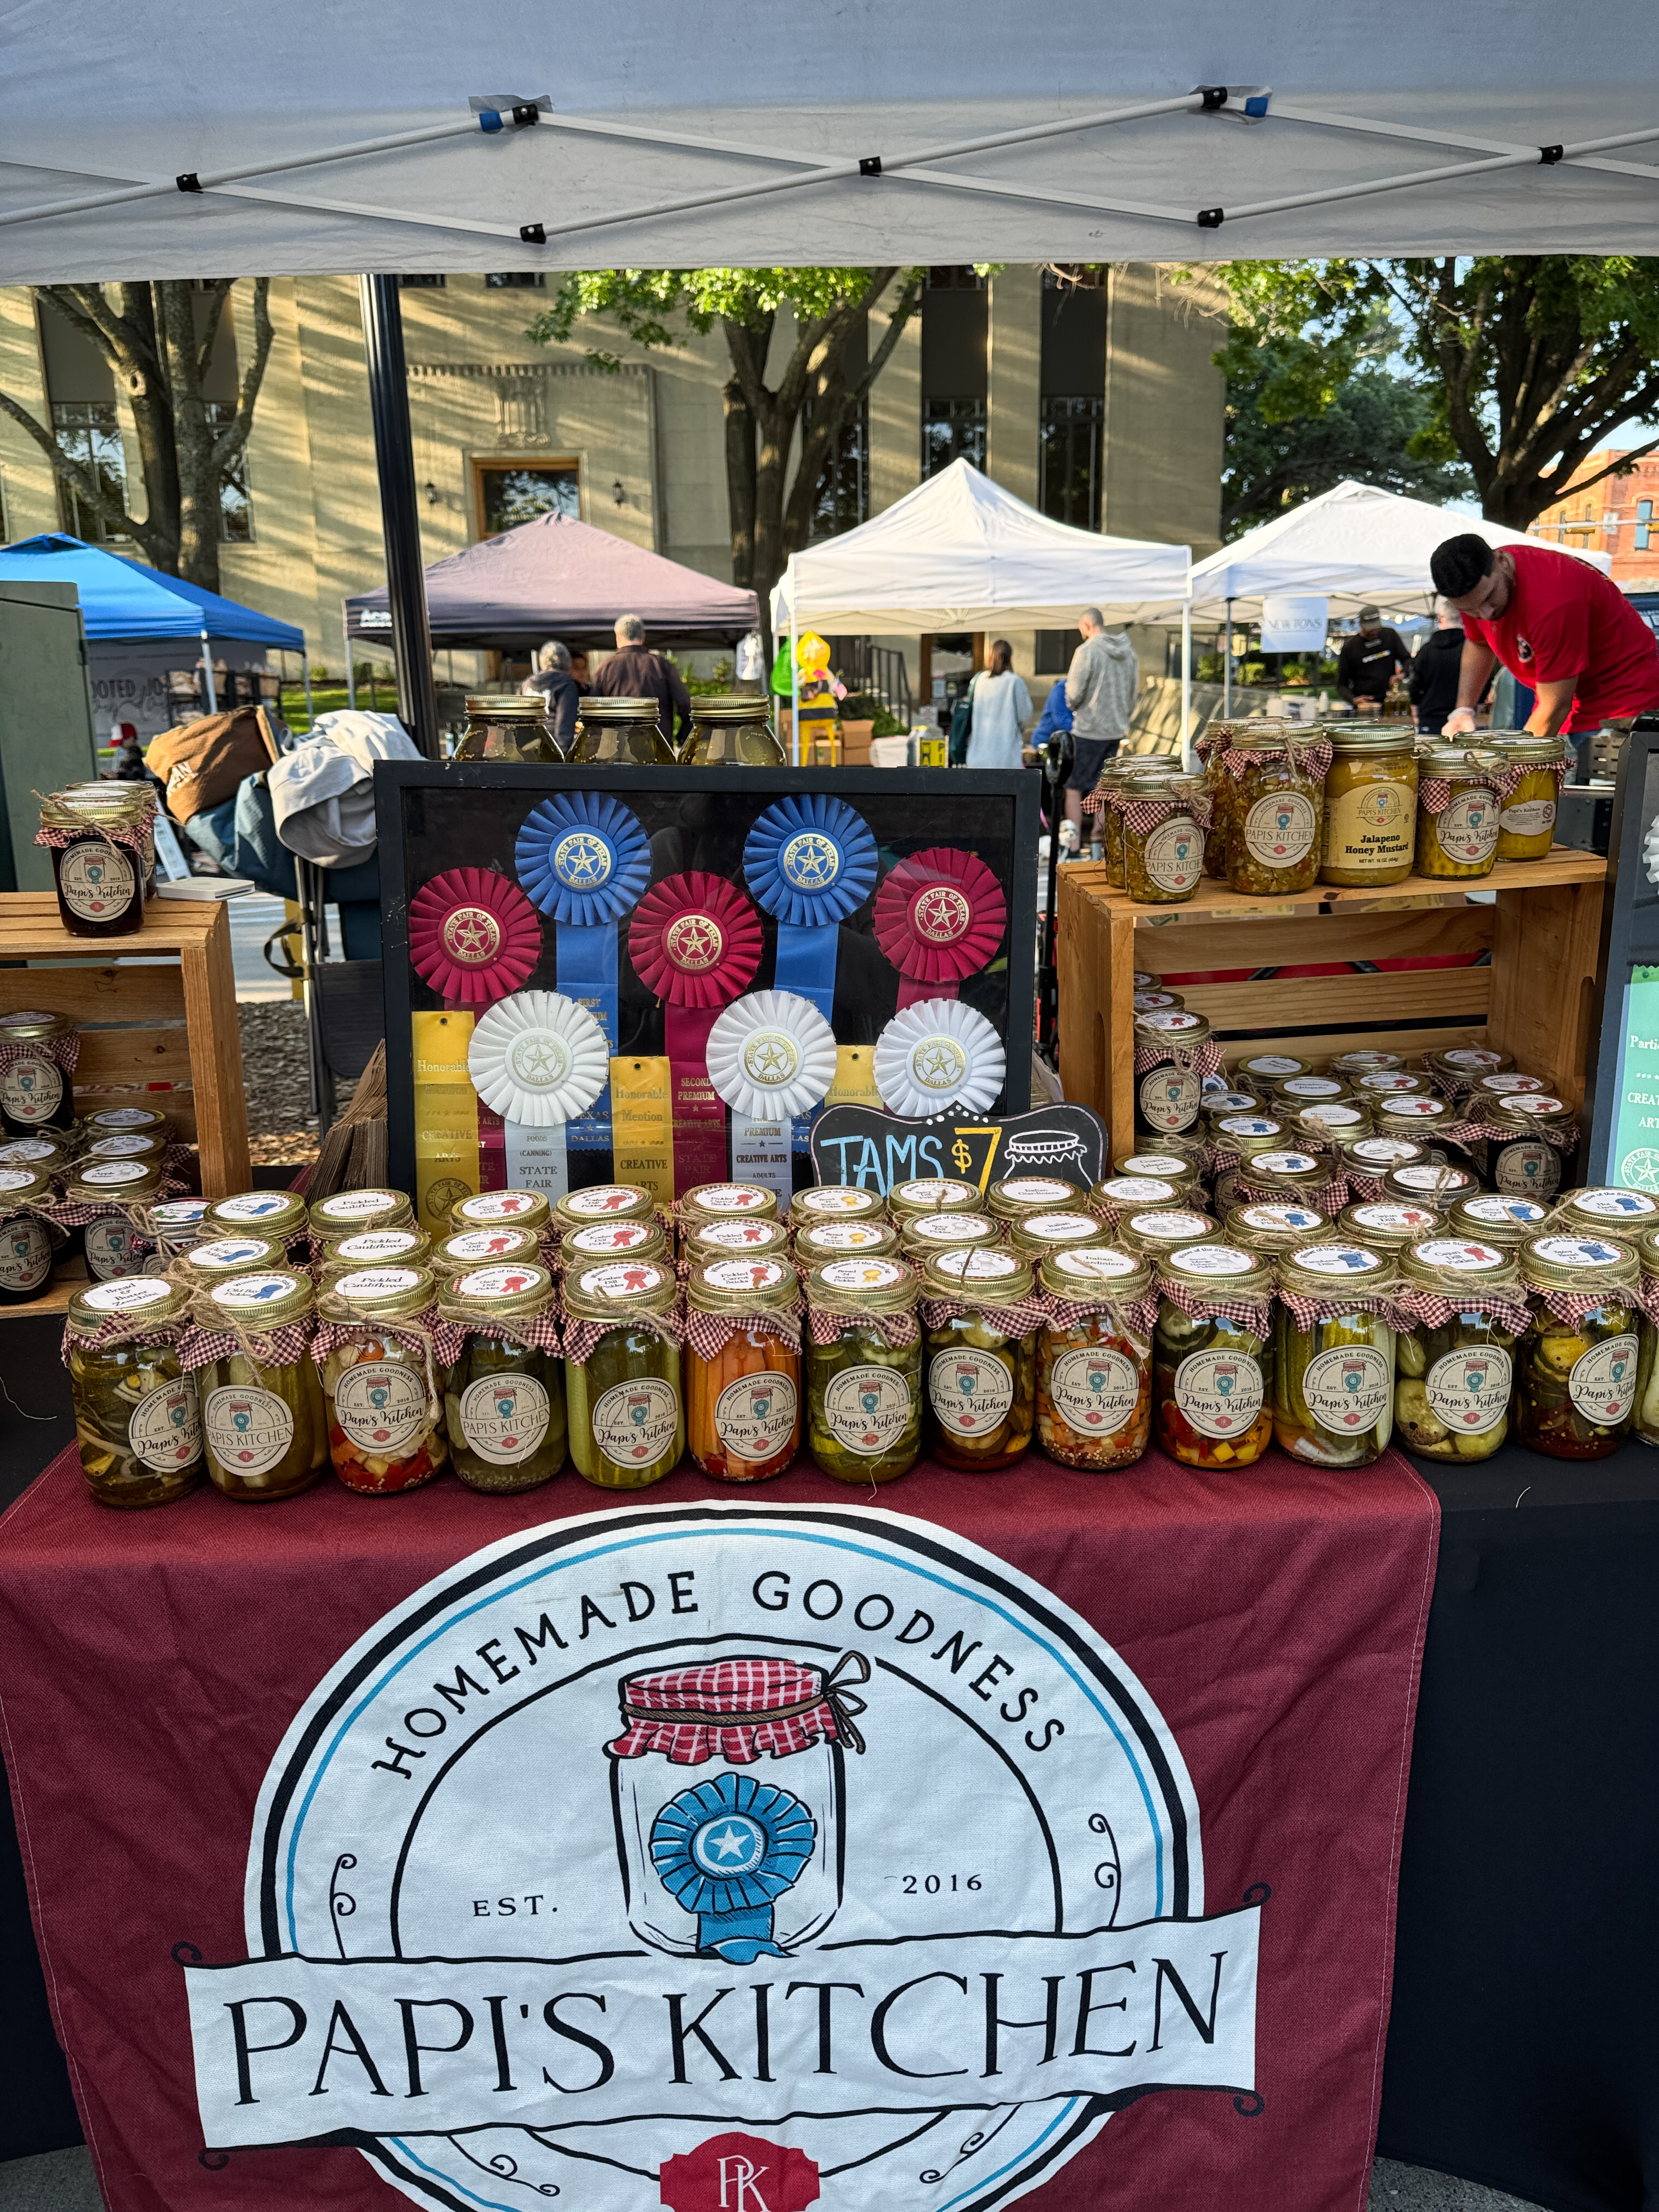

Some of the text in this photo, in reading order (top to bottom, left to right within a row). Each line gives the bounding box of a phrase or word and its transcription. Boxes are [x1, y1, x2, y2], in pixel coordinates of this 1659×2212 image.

[1447, 794, 1478, 812] HOMEMADE
[568, 837, 596, 847] FAIR OF
[1276, 831, 1314, 841] KITCHEN
[1360, 834, 1401, 844] Jalapeno
[1439, 830, 1471, 843] Papi's
[65, 848, 93, 865] HOMEMADE
[787, 844, 798, 867] STATE
[797, 837, 813, 847] FAIR
[824, 843, 835, 868] TEXAS
[1345, 842, 1409, 856] Honey Mustard
[569, 876, 597, 885] DALLAS
[797, 876, 825, 885] DALLAS
[64, 883, 132, 899] Papi's Kitchen
[919, 891, 966, 923] STATE FAIR OF TEXAS
[447, 912, 486, 940] STATE FAIR OF
[926, 928, 954, 938] DALLAS
[457, 950, 486, 960] DALLAS
[680, 957, 709, 966] DALLAS
[578, 998, 601, 1007] FIRST
[525, 1074, 554, 1083] DALLAS
[681, 1077, 712, 1087] SECOND
[758, 1072, 786, 1082] DALLAS
[924, 1076, 952, 1086] DALLAS
[1149, 1072, 1175, 1086] HOMEMADE
[28, 1092, 60, 1104] Kitchen
[615, 1086, 668, 1100] Honorable
[678, 1091, 715, 1101] PREMIUM
[1143, 1100, 1171, 1114] Papi's
[483, 1116, 500, 1125] ARTS
[622, 1109, 663, 1122] Mention
[672, 1119, 721, 1128] CREATIVE ARTS
[421, 1130, 472, 1140] CREATIVE
[744, 1127, 781, 1137] PREMIUM
[434, 1153, 461, 1163] ARTS
[736, 1154, 787, 1164] CREATIVE ARTS
[1503, 1146, 1532, 1157] HOMEMADE
[519, 1166, 557, 1175] STATE
[620, 1159, 668, 1169] CREATIVE
[820, 1135, 944, 1199] TAMS
[525, 1180, 552, 1188] FAIR
[635, 1181, 658, 1190] ARTS
[1498, 1173, 1559, 1189] Papi's Kitchen
[330, 1201, 392, 1211] Cauliflower
[342, 1198, 379, 1206] Pickled
[88, 1250, 116, 1265] Papi's
[360, 1276, 403, 1284] Pickled
[104, 1283, 136, 1294] Bread
[113, 1289, 149, 1301] Butter
[111, 1291, 160, 1307] Zucchini
[1587, 1341, 1622, 1364] HOMEMADE
[936, 1355, 1001, 1375] HOMEMADE GOODNESS
[1063, 1351, 1131, 1372] HOMEMADE GOODNESS
[1189, 1355, 1257, 1373] HOMEMADE GOODNESS
[1316, 1352, 1384, 1372] HOMEMADE GOODNESS
[343, 1368, 414, 1389] HOMEMADE GOODNESS
[836, 1373, 870, 1392] HOMEMADE
[473, 1380, 535, 1402] HOMEMADE GOODNESS
[603, 1385, 669, 1408] HOMEMADE GOODNESS
[726, 1378, 791, 1401] HOMEMADE GOODNESS
[1573, 1385, 1614, 1401] Papi's
[140, 1387, 176, 1418] HOMEMADE
[211, 1394, 236, 1412] HOMEMADE
[932, 1389, 1009, 1414] Papi's Kitchen
[1056, 1386, 1135, 1411] Papi's Kitchen
[1182, 1392, 1262, 1413] Papi's Kitchen
[1308, 1391, 1387, 1410] Papi's Kitchen
[1429, 1390, 1508, 1409] Papi's Kitchen
[341, 1406, 424, 1427] Papi's Kitchen
[500, 1408, 550, 1431] KITCHEN
[830, 1408, 909, 1430] Papi's Kitchen
[598, 1420, 675, 1444] Papi's Kitchen
[720, 1414, 795, 1437] Papi's Kitchen
[237, 1425, 293, 1446] KITCHEN
[137, 1433, 180, 1457] Papi's
[371, 1571, 1065, 1780] HOMEMADE GOODNESS
[472, 1874, 983, 1917] EST. 2016
[223, 1951, 1228, 2106] PAPI'S KITCHEN
